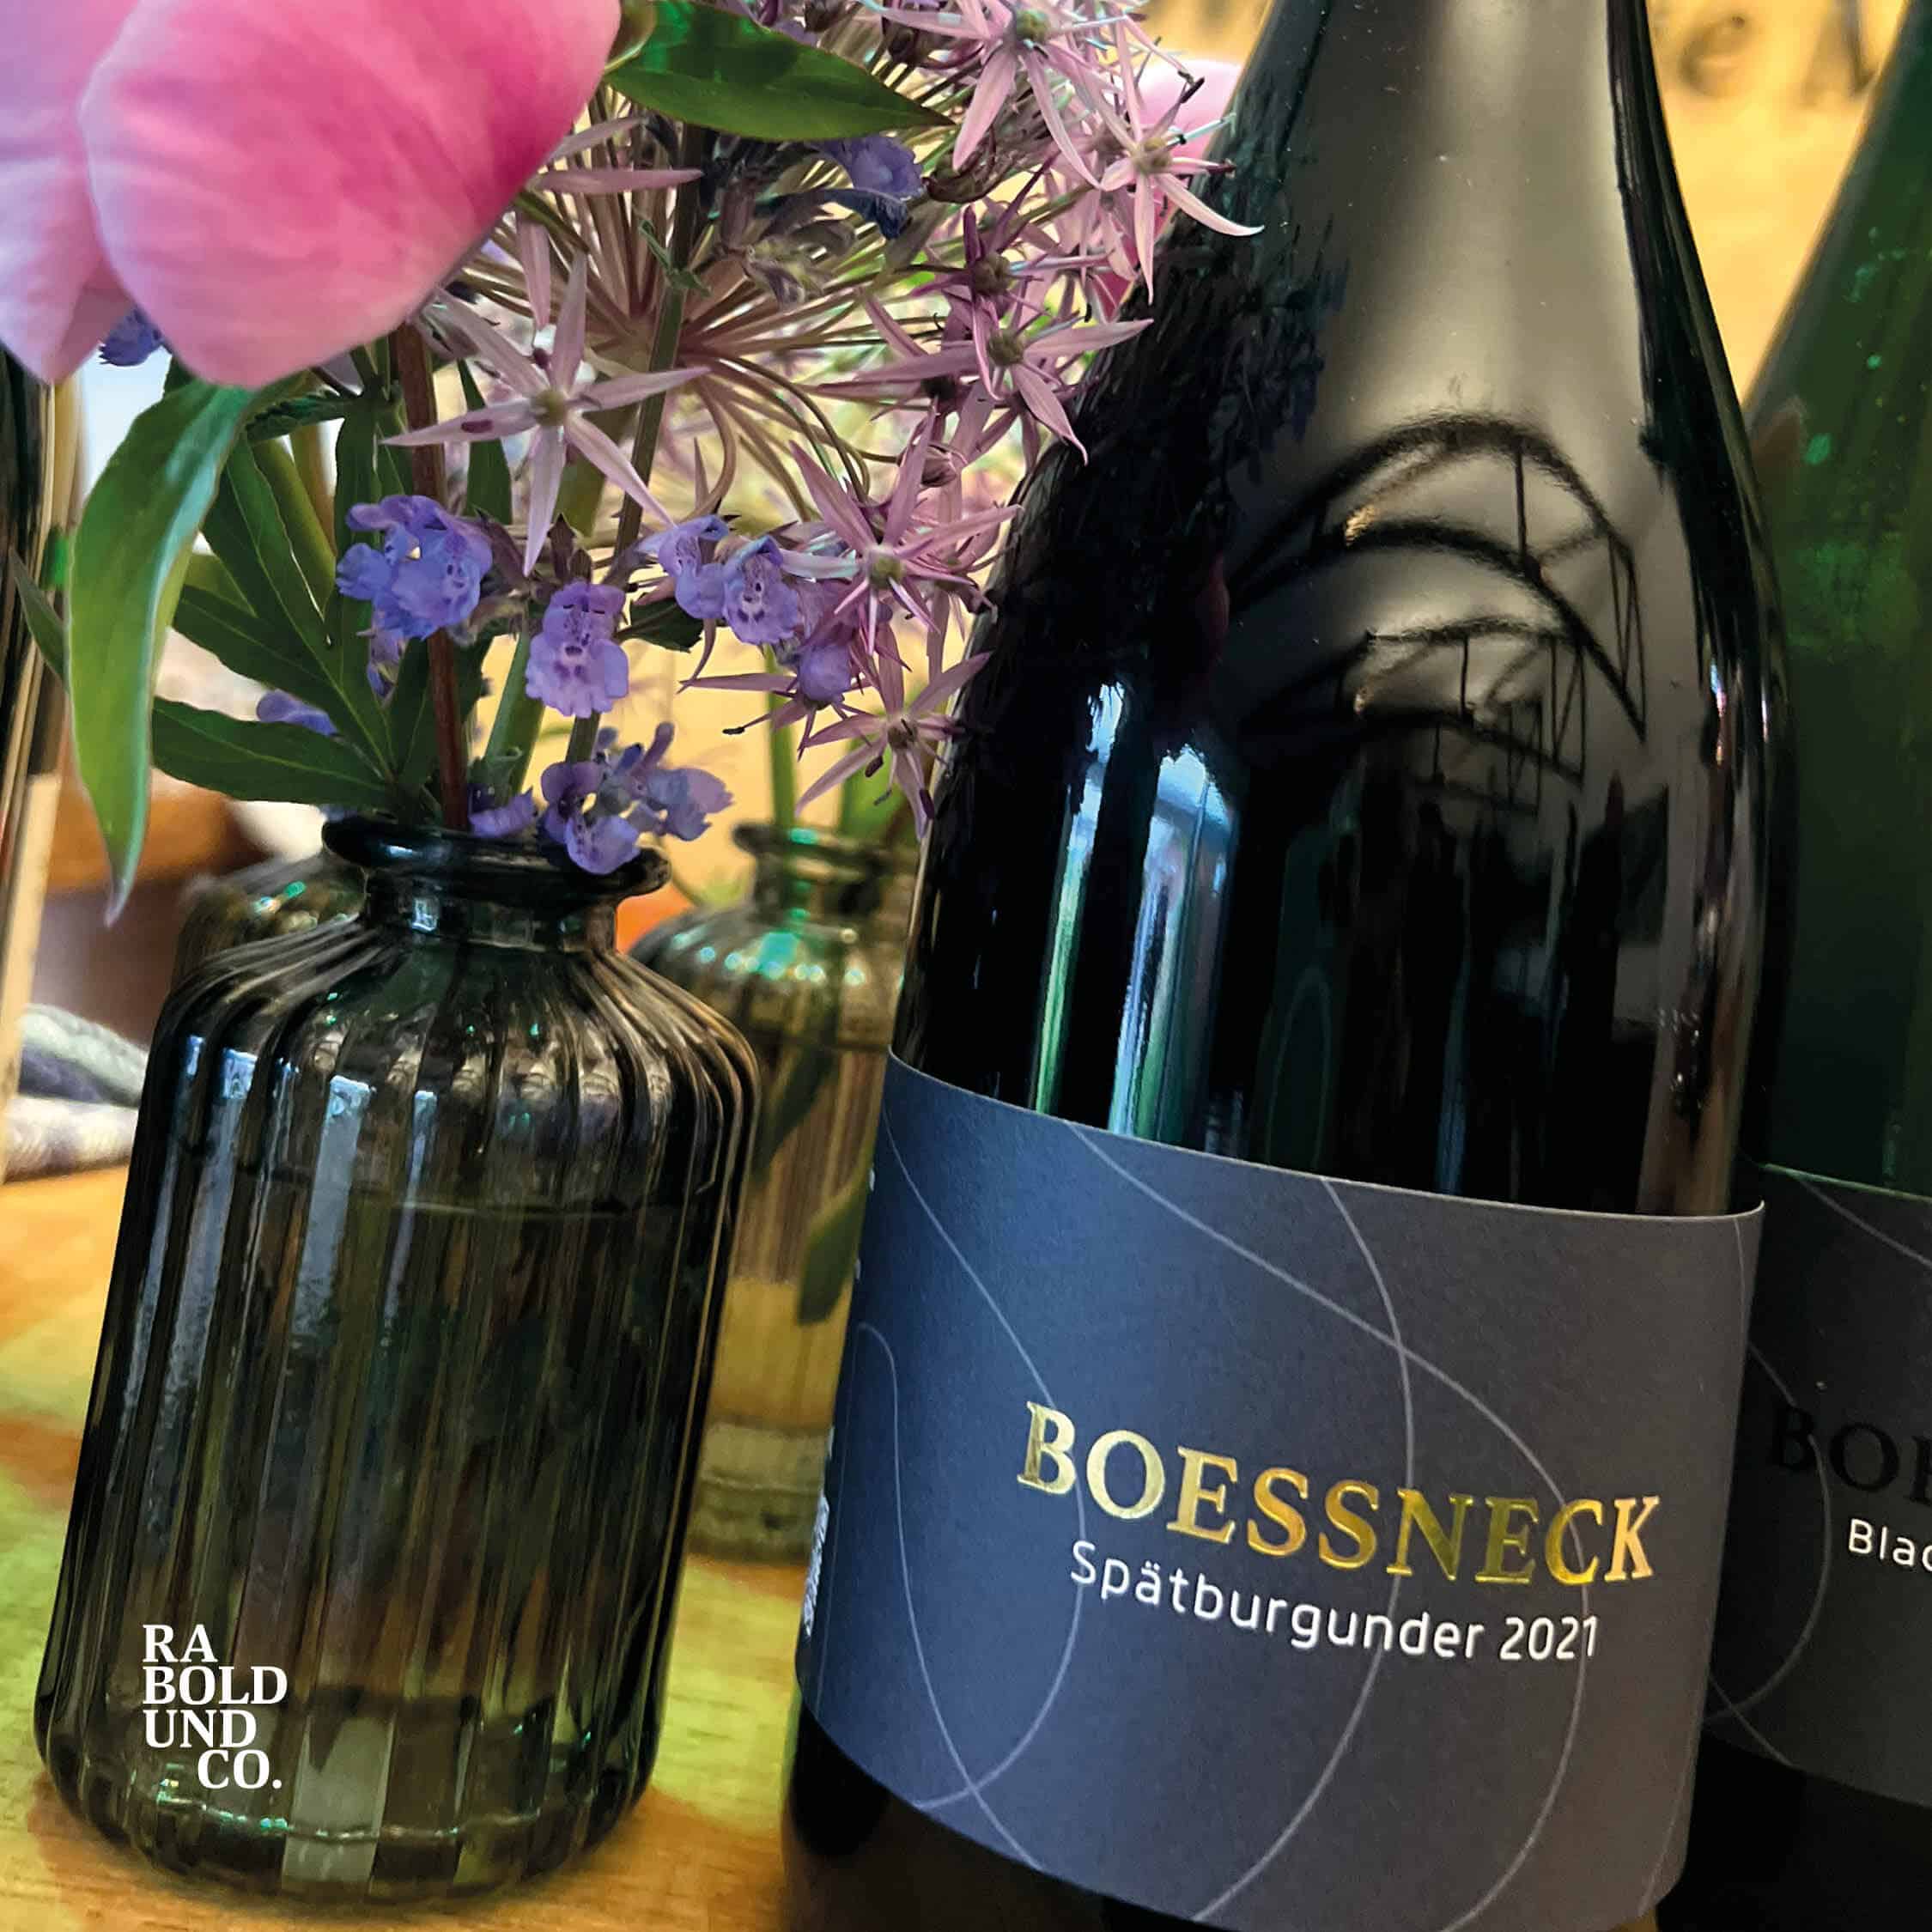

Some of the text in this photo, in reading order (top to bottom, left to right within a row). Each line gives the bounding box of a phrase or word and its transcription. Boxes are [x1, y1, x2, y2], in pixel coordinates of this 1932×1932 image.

[1017, 1400, 1661, 1587] BOESSNECK
[1070, 1540, 1600, 1662] Spätburgunder 2021
